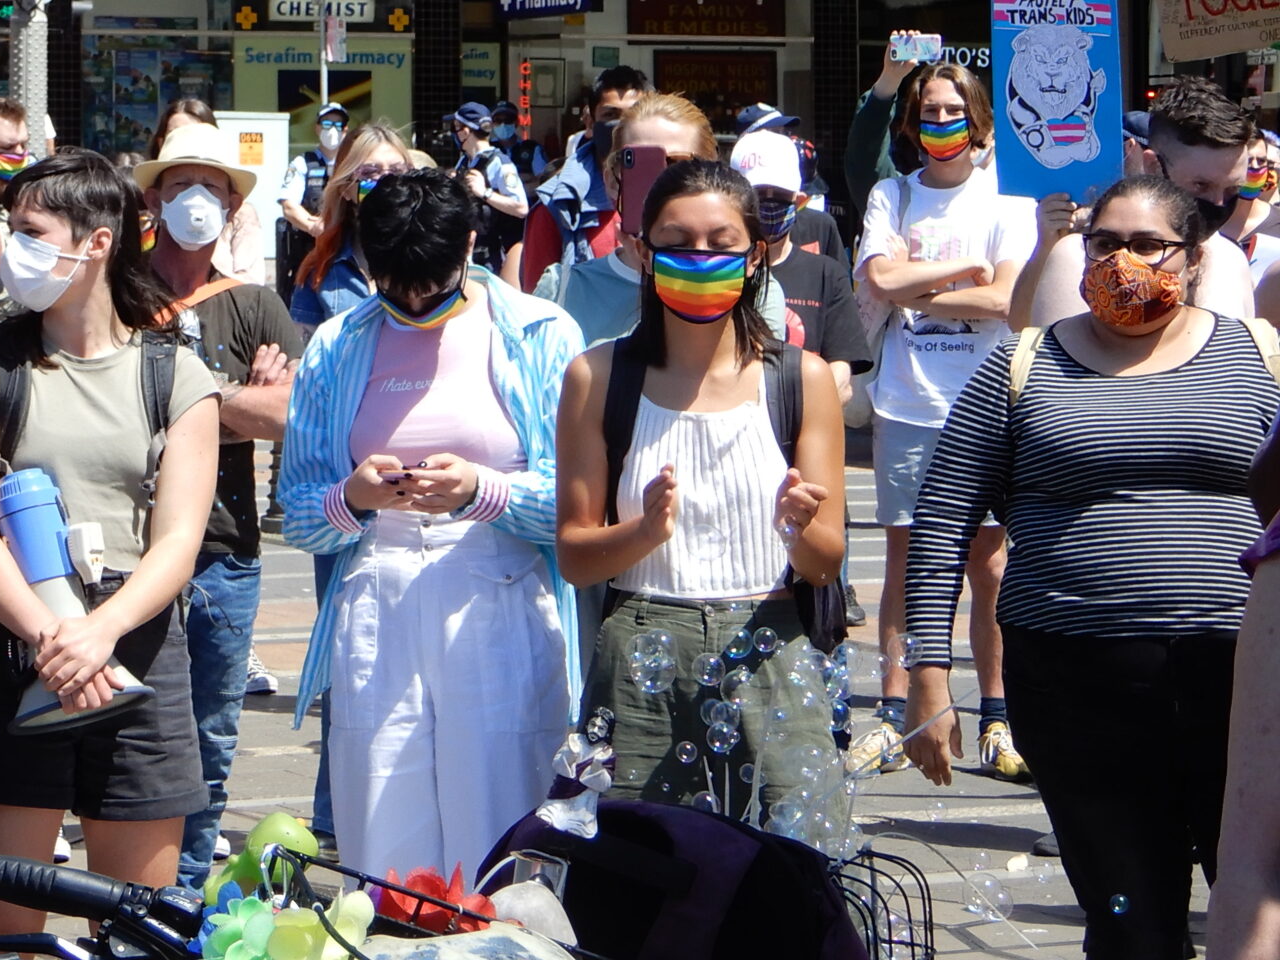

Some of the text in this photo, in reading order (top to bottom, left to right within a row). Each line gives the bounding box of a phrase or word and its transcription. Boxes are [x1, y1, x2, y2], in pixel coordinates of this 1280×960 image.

[276, 0, 368, 17] CHEMIST
[668, 4, 746, 18] FAMILY
[1006, 7, 1095, 25] TRANS KIDS
[645, 19, 768, 34] REMEDIES
[245, 47, 406, 68] Serafim armacy
[665, 63, 766, 77] HOSPITAL NEEDS
[665, 79, 766, 93] KODAK FILM
[924, 342, 938, 351] Of
[385, 377, 414, 392] hate
